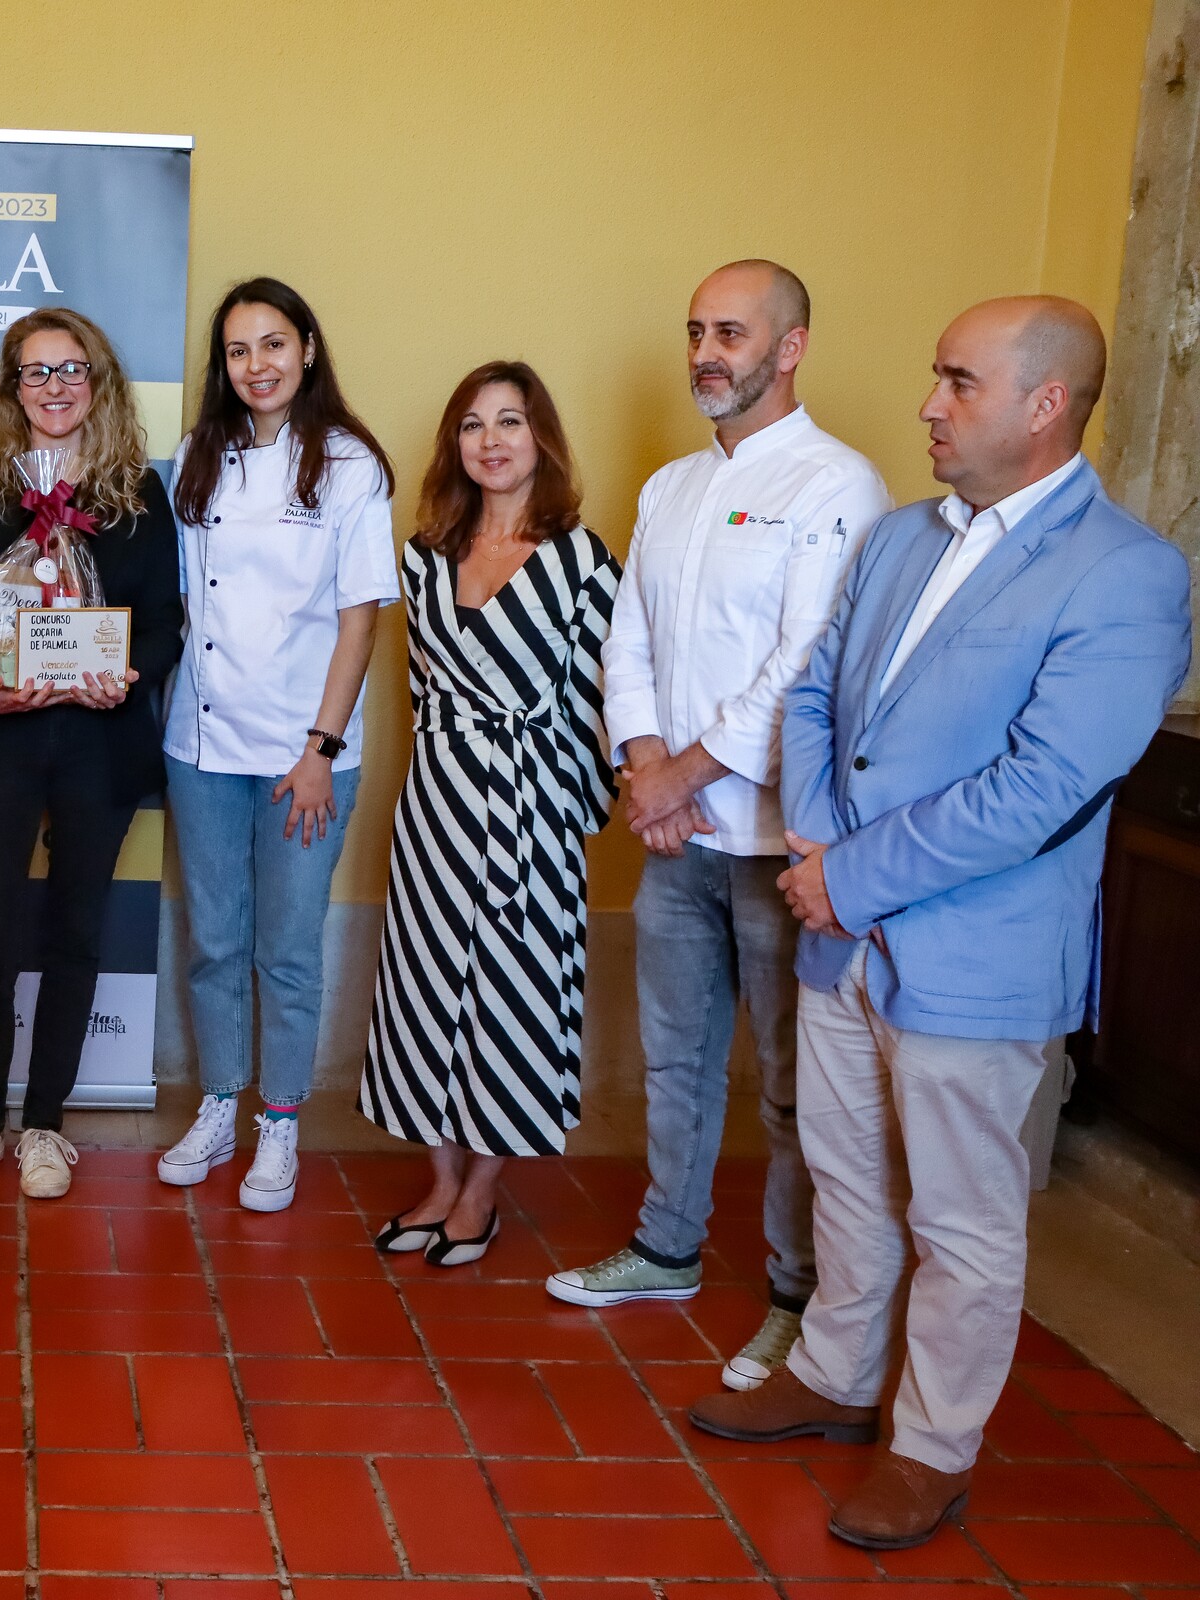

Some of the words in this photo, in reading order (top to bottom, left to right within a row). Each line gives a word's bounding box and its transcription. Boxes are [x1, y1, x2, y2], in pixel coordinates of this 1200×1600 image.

[285, 508, 321, 520] PALMELA
[30, 614, 71, 625] CONCURSO
[30, 627, 63, 639] DOÇARIA
[30, 640, 40, 650] DE
[41, 640, 78, 650] PALMELA
[41, 660, 79, 670] Vencedor
[36, 671, 77, 681] Absoluto
